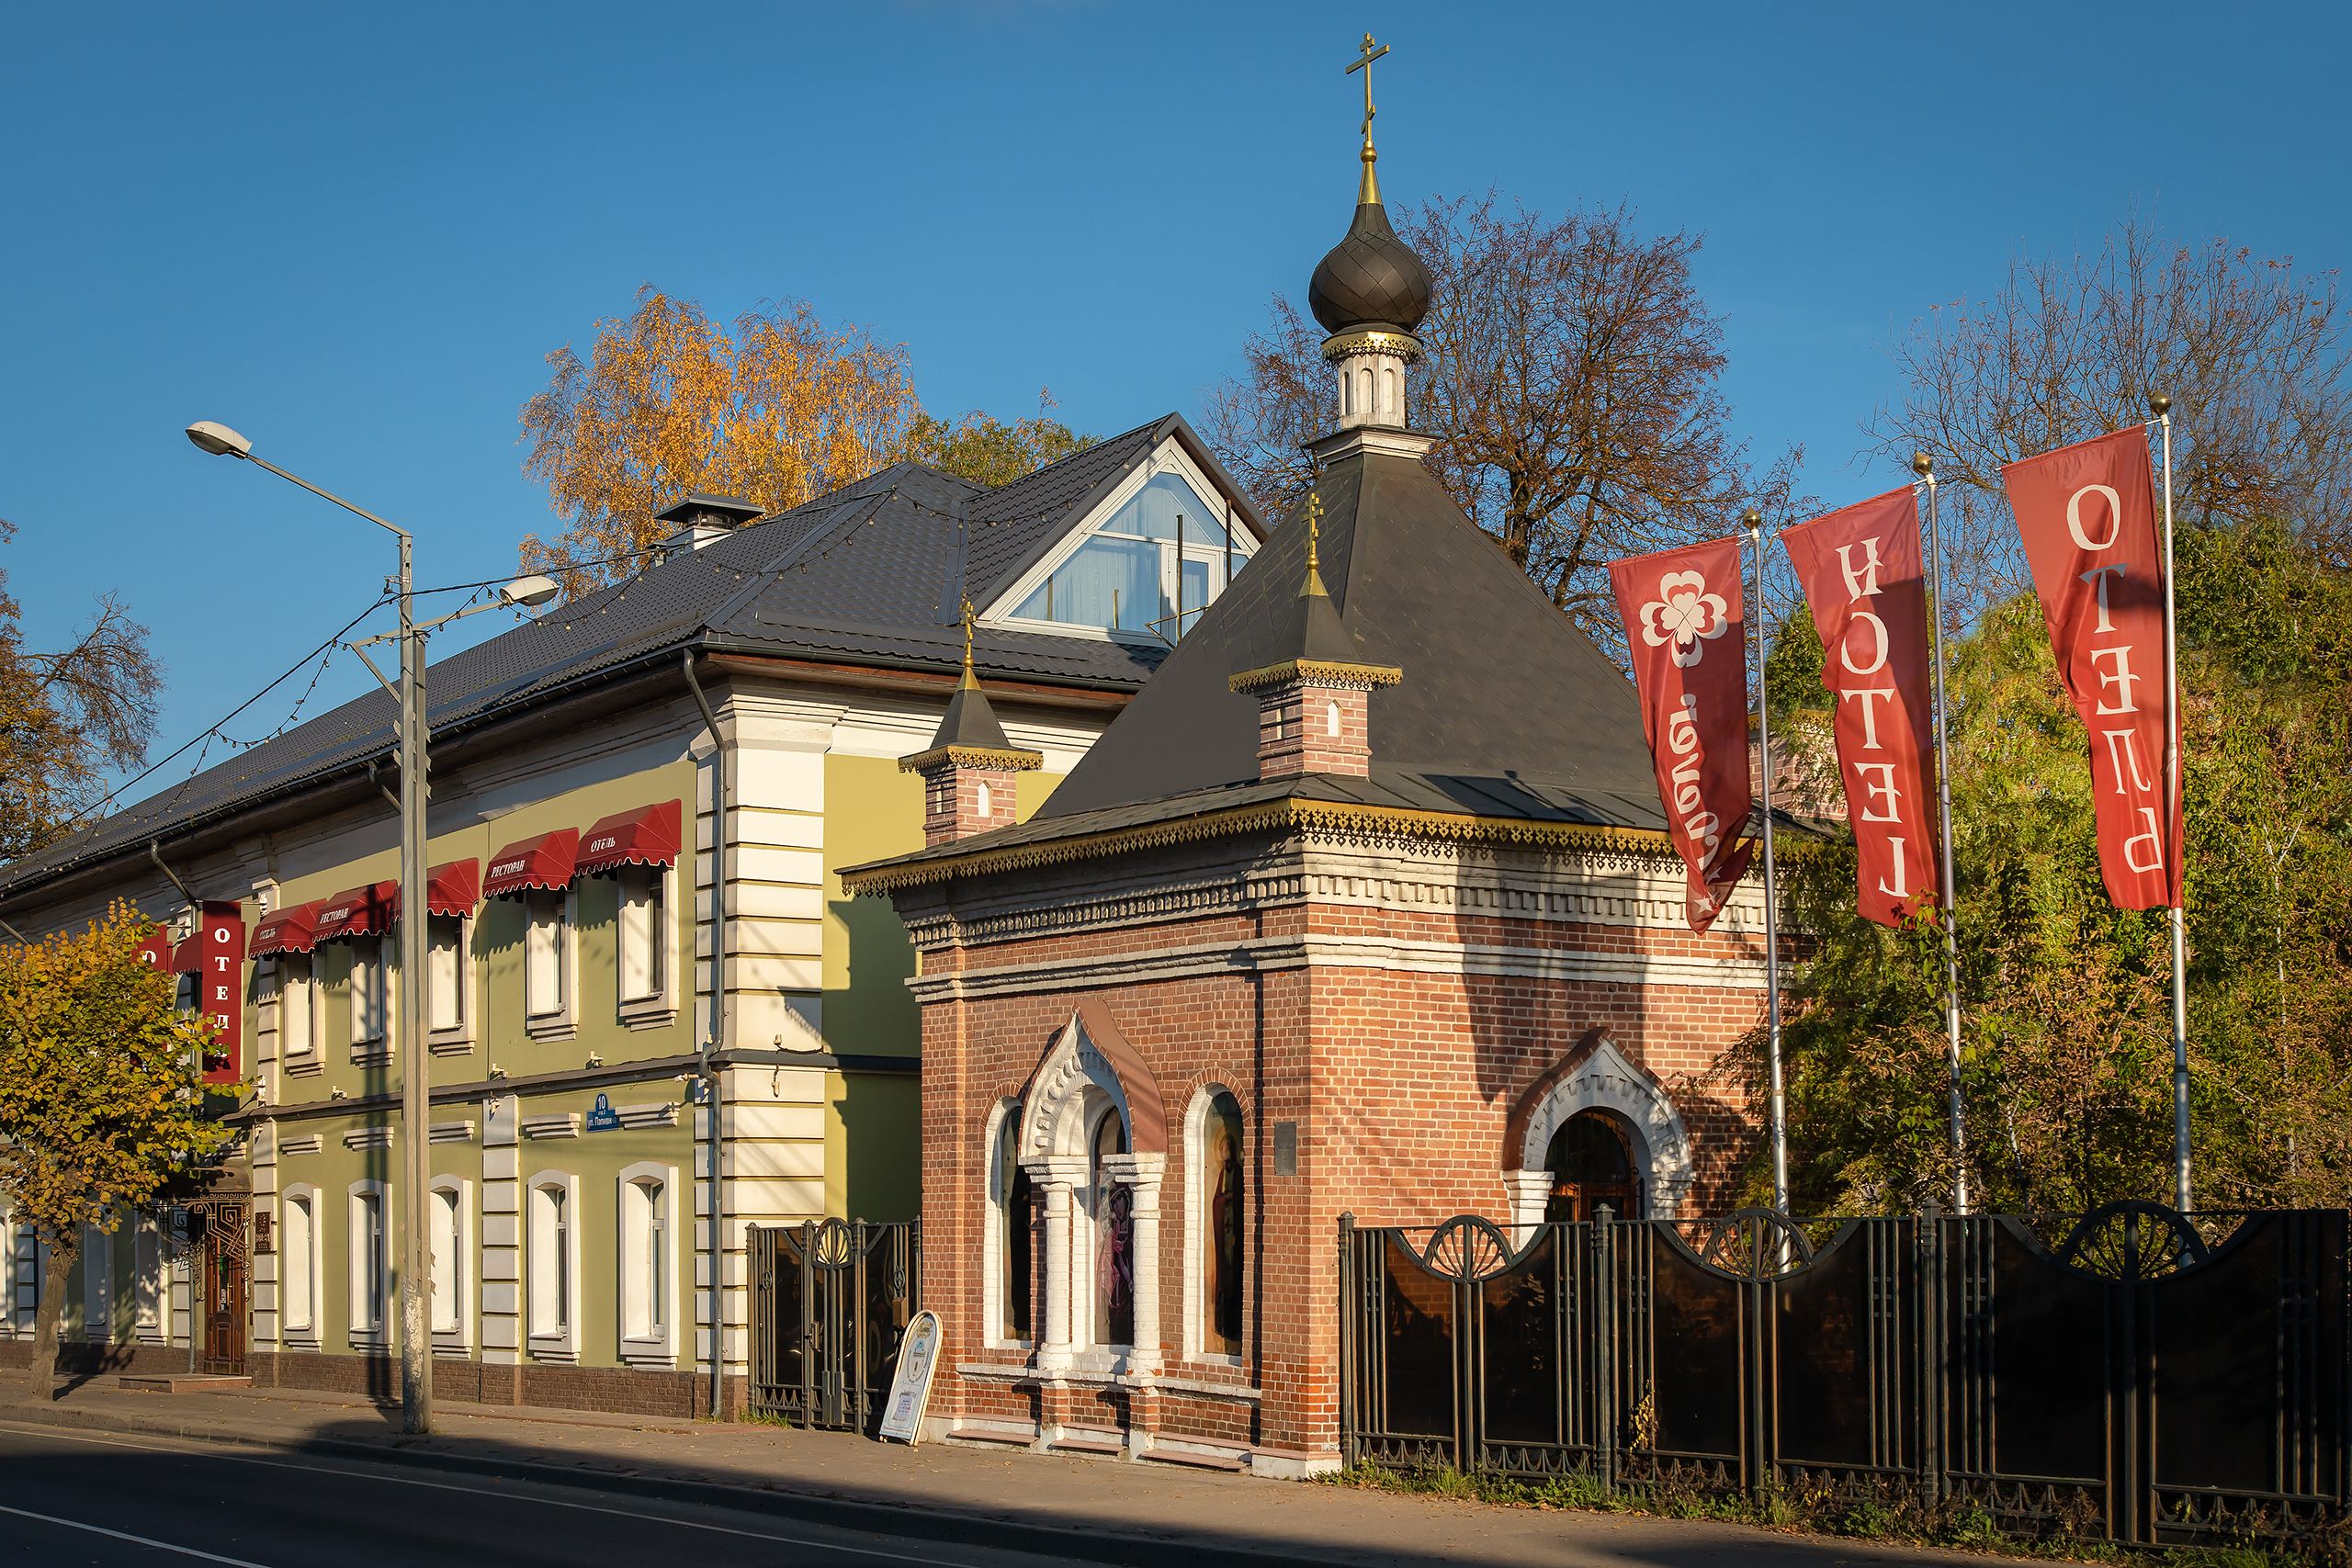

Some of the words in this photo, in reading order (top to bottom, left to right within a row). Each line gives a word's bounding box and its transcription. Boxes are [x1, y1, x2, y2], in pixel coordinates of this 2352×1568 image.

[590, 836, 616, 852] ОТЕЛЬ
[490, 859, 526, 878] РЕСТОРАН
[319, 907, 349, 924] РЕСТОРАН
[598, 1096, 606, 1110] 10
